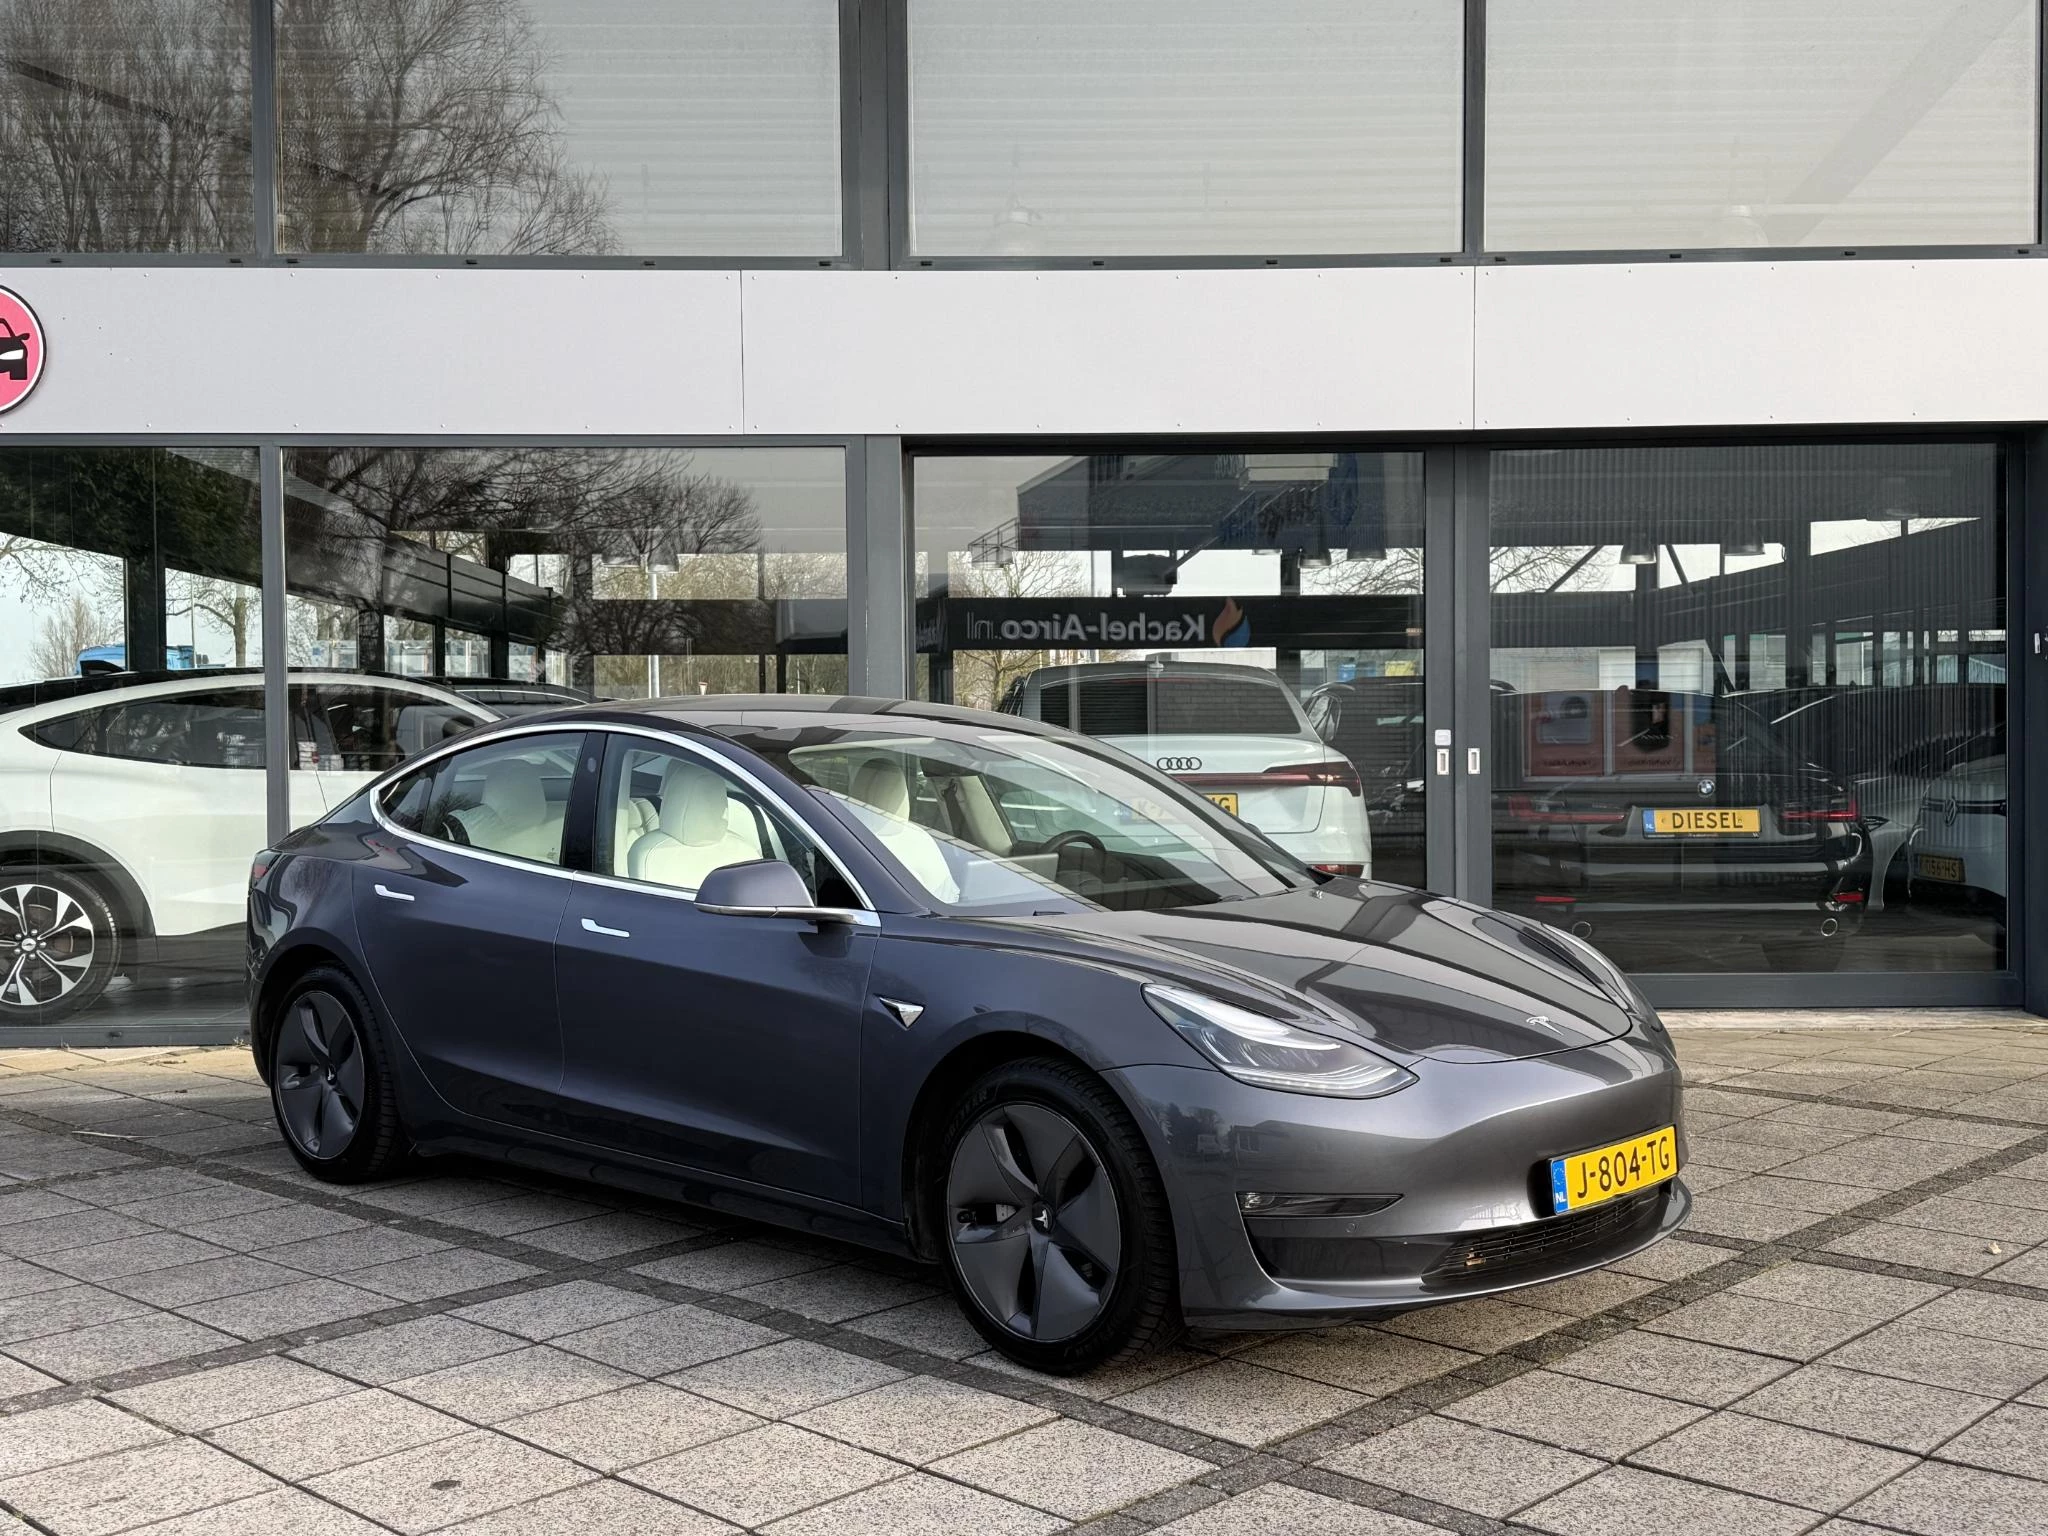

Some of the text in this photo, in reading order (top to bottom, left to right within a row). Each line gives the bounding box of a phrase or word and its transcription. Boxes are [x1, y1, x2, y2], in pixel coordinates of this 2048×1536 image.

[1672, 812, 1743, 829] DIESEL
[1577, 1136, 1670, 1199] J-804-TG
[1555, 1192, 1567, 1204] NL
